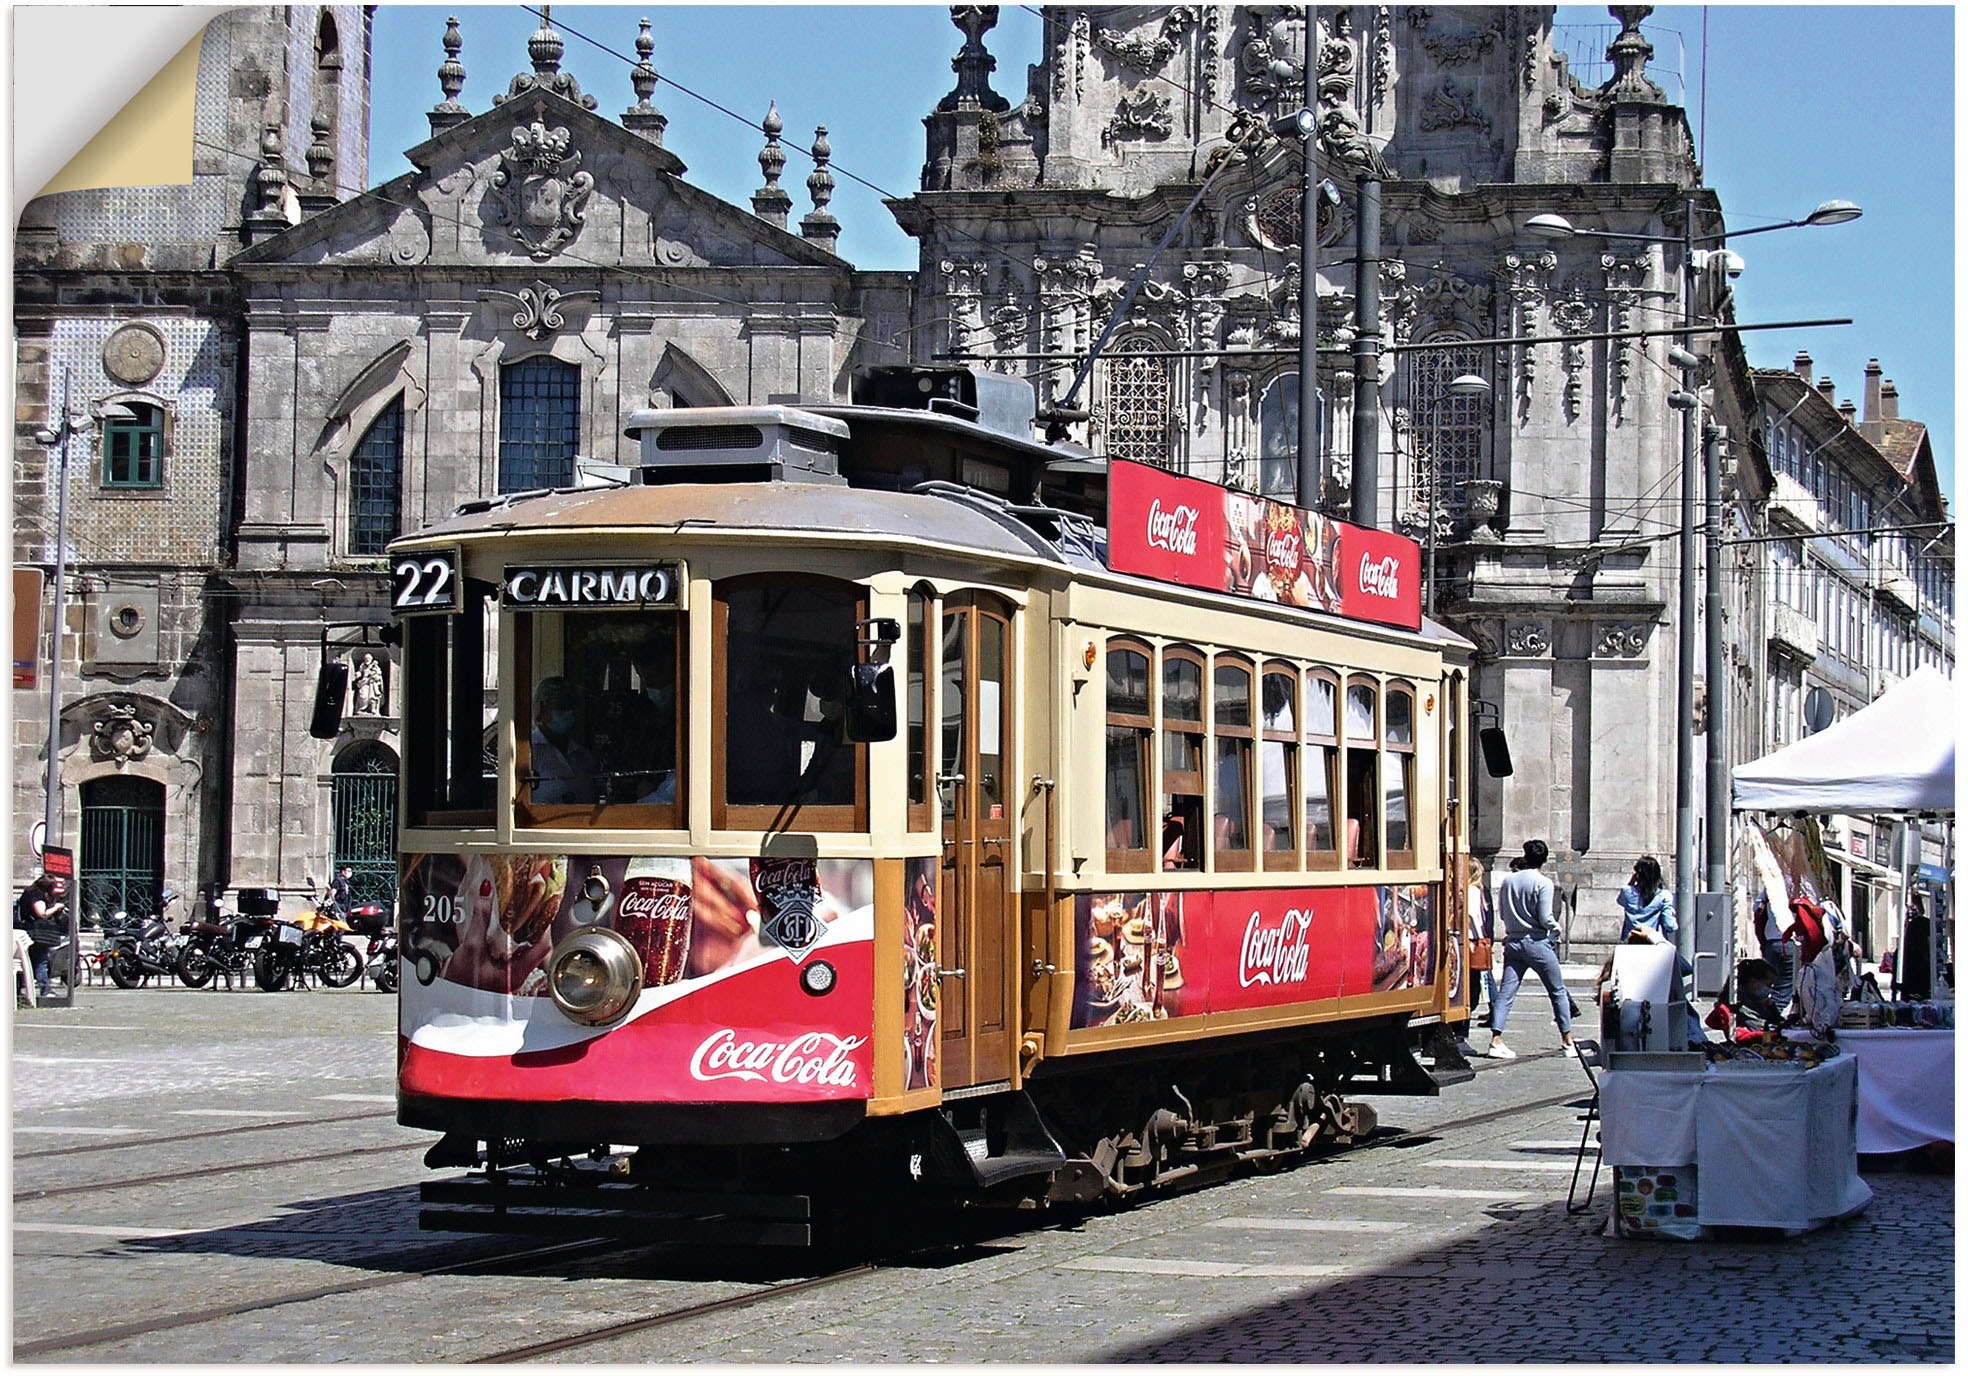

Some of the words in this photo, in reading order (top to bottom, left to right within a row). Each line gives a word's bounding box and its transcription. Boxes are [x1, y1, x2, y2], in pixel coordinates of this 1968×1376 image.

[1147, 498, 1200, 556] Coca-Cola
[396, 560, 449, 606] 22
[509, 570, 670, 602] CARMO
[423, 895, 466, 924] 205
[620, 891, 691, 921] Coca-Cola
[1239, 909, 1313, 988] Coca-Cola
[690, 1028, 868, 1088] Coca-Cola
